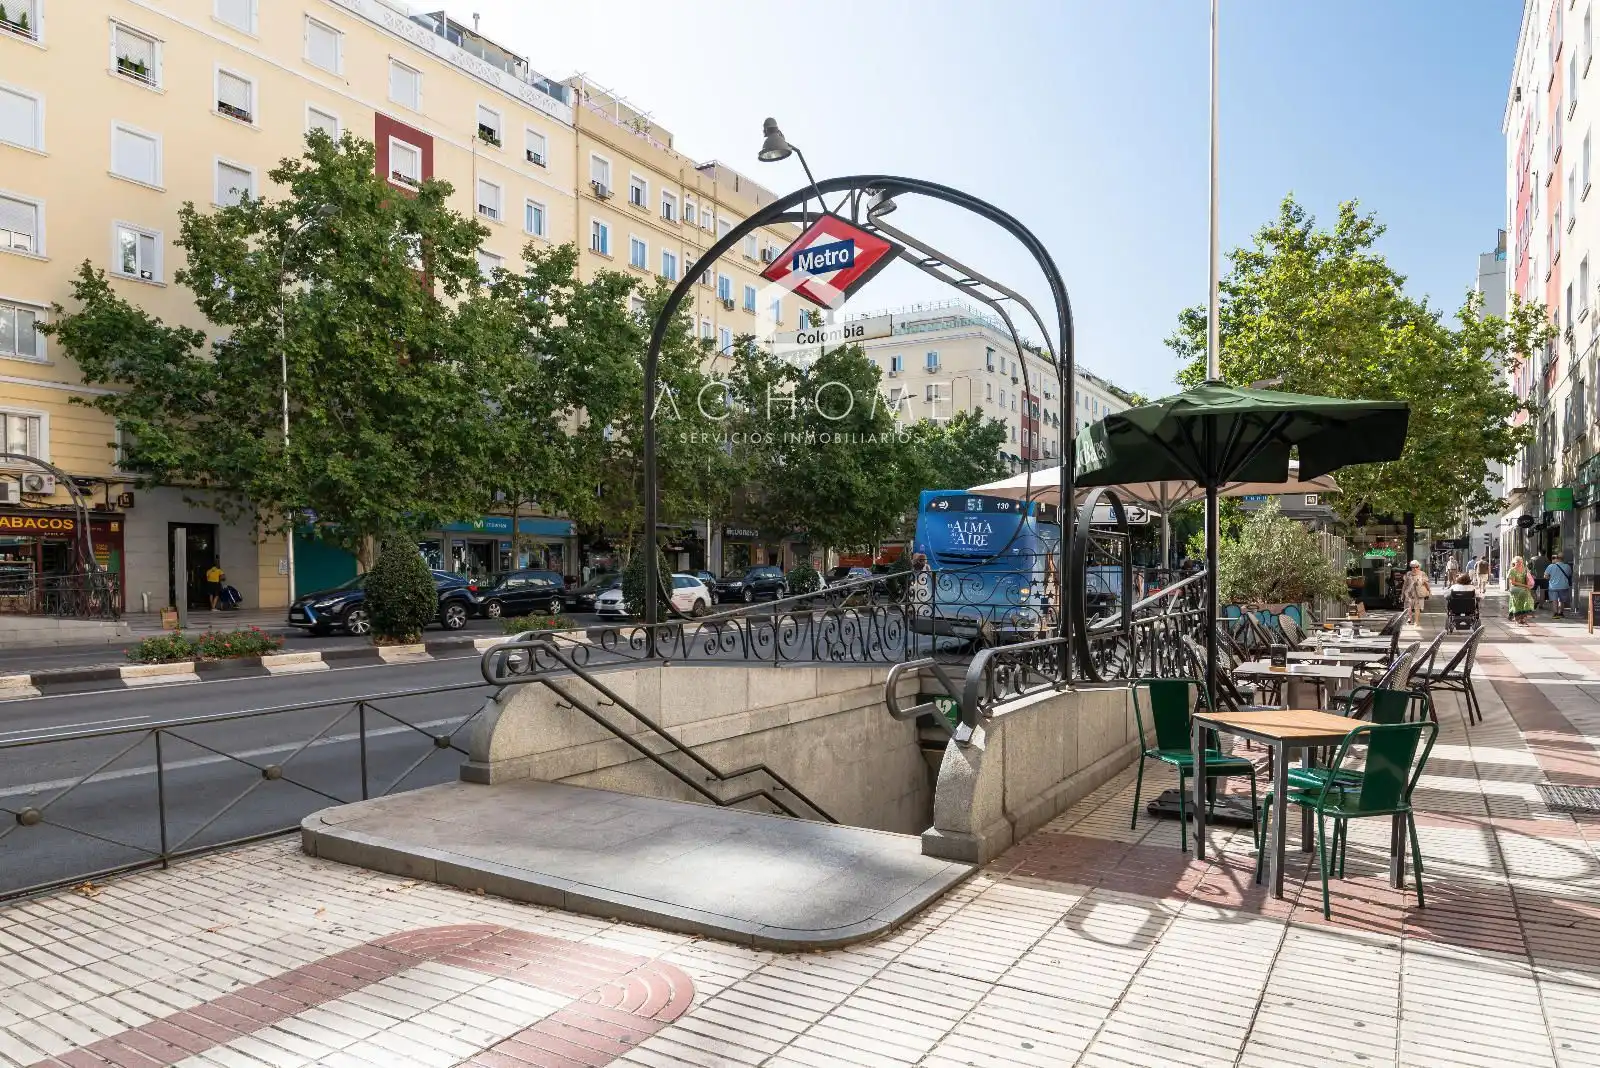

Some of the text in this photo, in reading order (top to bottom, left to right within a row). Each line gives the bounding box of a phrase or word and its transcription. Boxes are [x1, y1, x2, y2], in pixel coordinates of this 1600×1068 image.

[798, 248, 849, 272] Metro
[796, 323, 865, 345] Colombia
[967, 498, 1010, 511] 51 130
[954, 532, 989, 547] AIRE
